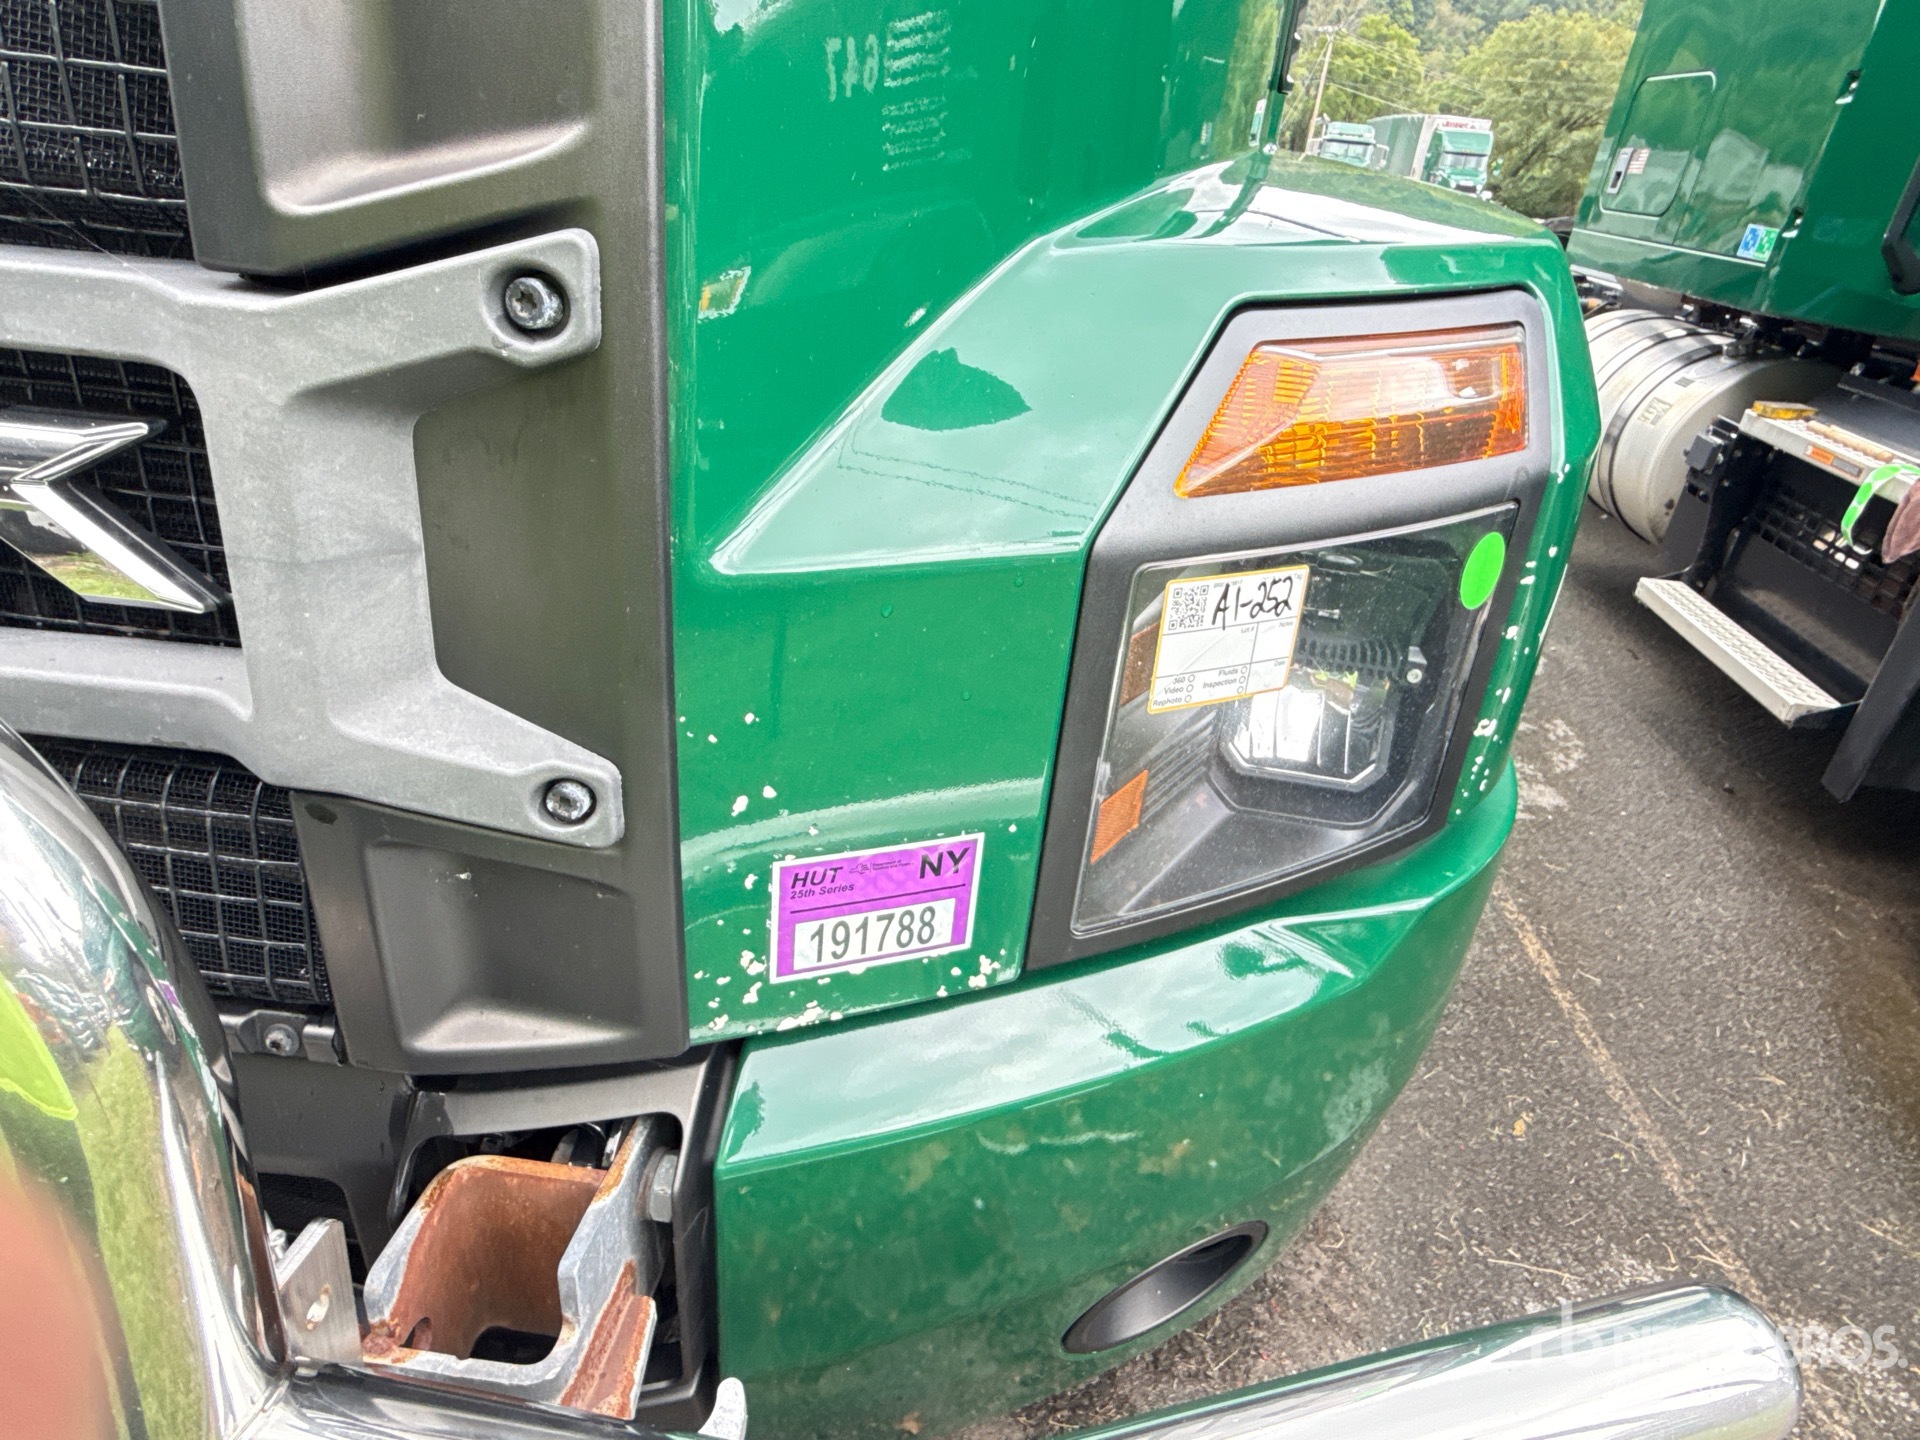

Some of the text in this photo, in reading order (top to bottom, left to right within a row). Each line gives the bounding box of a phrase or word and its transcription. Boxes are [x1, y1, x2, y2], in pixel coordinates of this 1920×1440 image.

[1212, 576, 1293, 631] A1-252
[1218, 668, 1239, 677] Fluids
[1173, 677, 1186, 685] 360
[1203, 677, 1237, 689] Inspection
[1164, 686, 1184, 695] Video
[1153, 696, 1183, 707] Rephoto
[919, 847, 970, 879] NY
[791, 866, 843, 889] HUT
[790, 883, 855, 900] 25th Series
[810, 905, 936, 963] 191788
